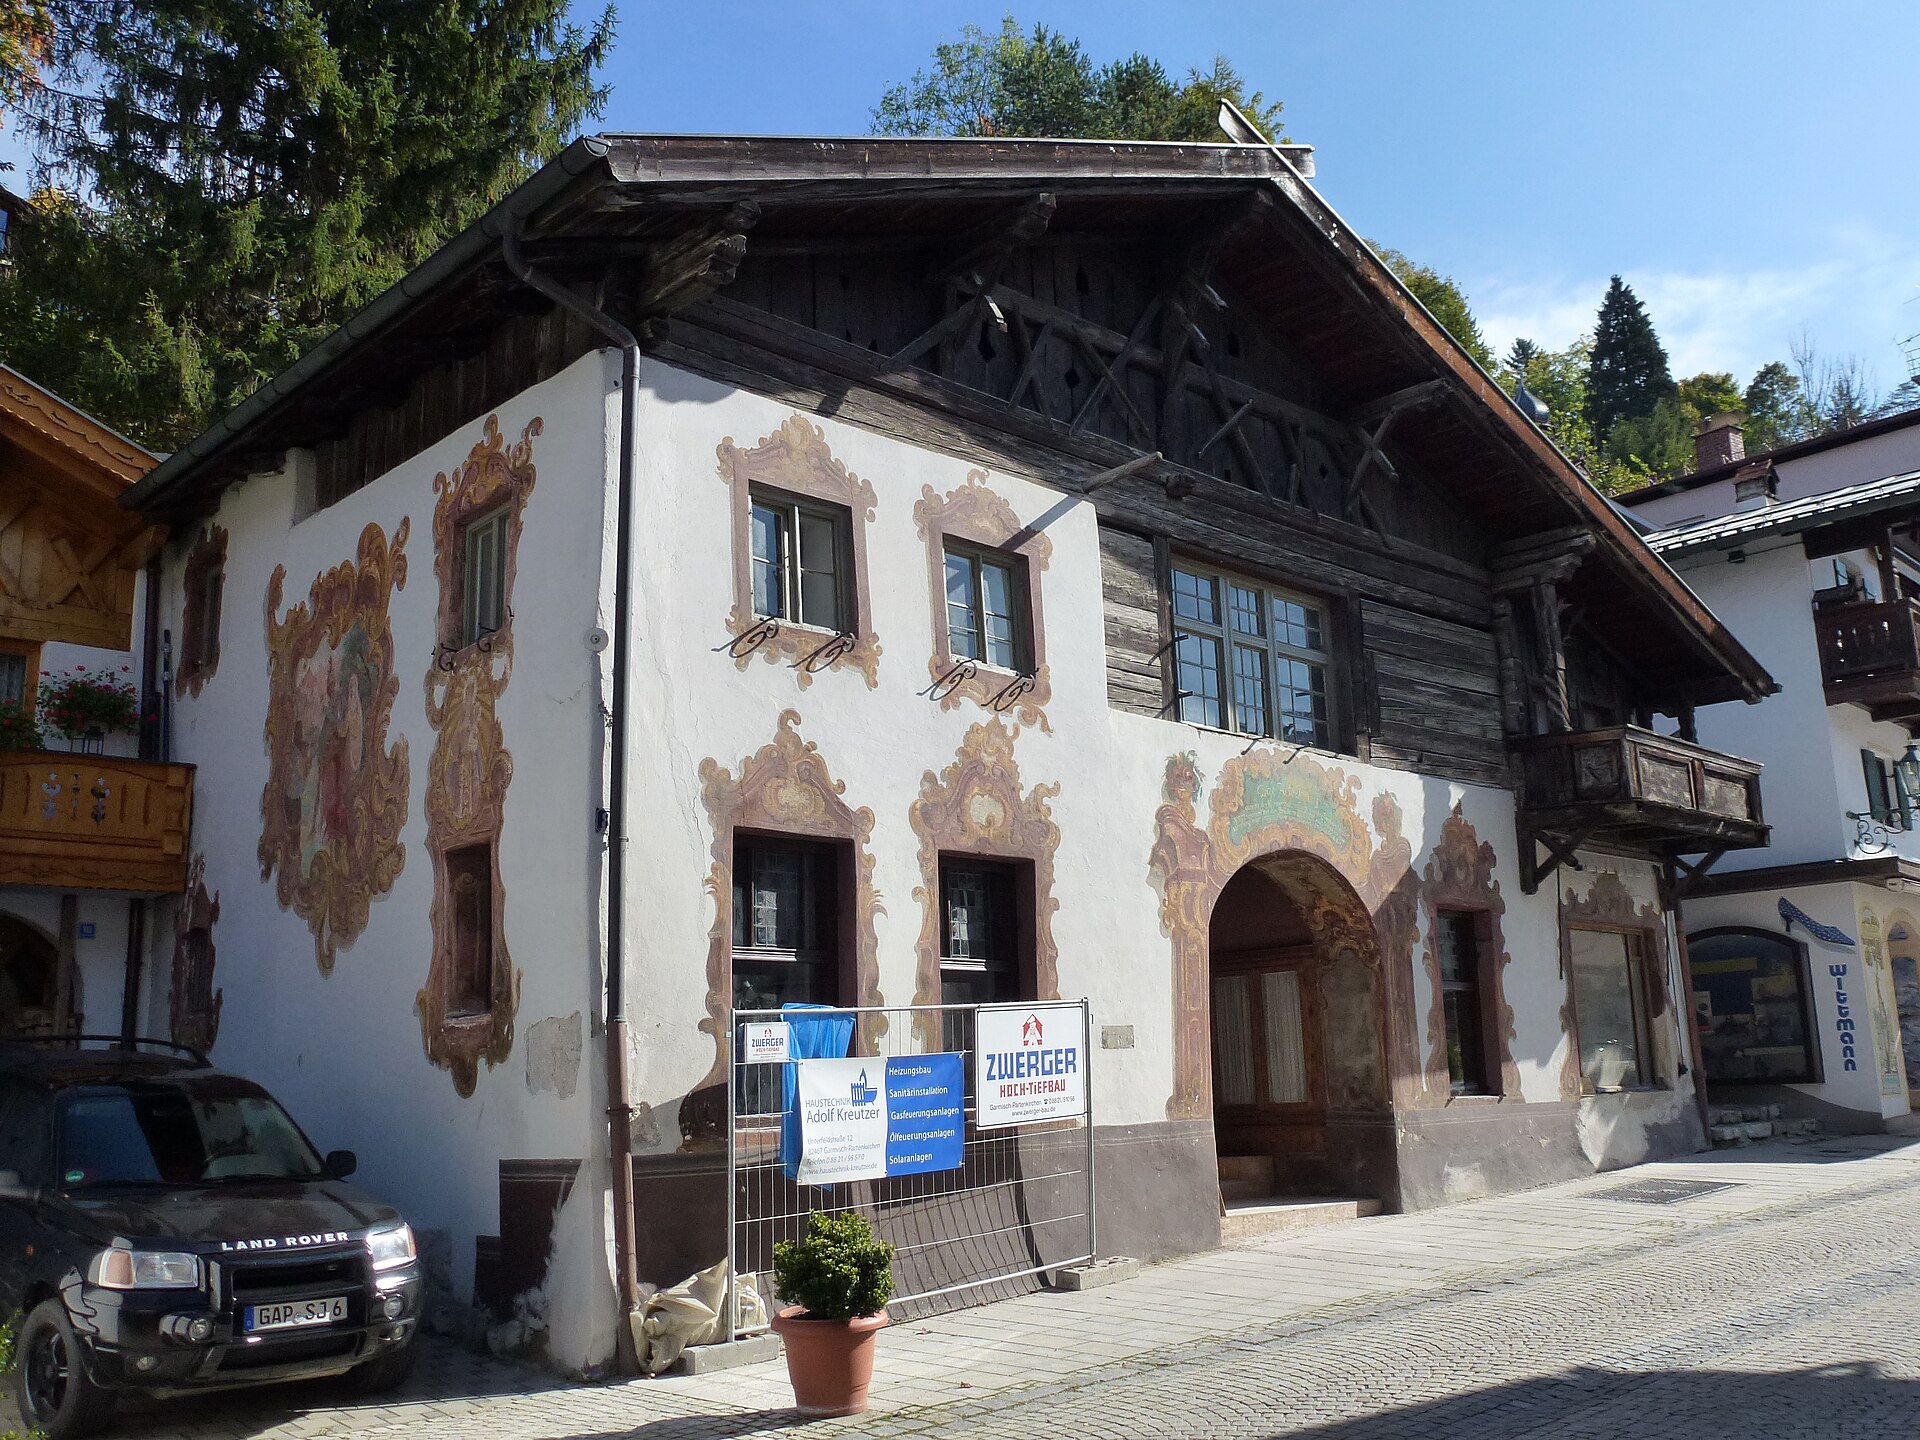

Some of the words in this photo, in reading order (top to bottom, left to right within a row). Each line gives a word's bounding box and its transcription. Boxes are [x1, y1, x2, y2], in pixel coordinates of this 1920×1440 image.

[751, 1037, 784, 1048] ZWERGER
[986, 1047, 1077, 1081] ZWERGER
[888, 1065, 932, 1077] Heizungsbau
[889, 1085, 948, 1098] Sanitärinstallation
[805, 1097, 851, 1108] HAUSTECHNIK
[806, 1107, 834, 1123] Adolf
[837, 1108, 880, 1121] Kreutzer
[890, 1106, 960, 1120] Gasfeuerungsanlagen
[847, 1134, 854, 1143] 12
[889, 1128, 955, 1142] Ölfeuerungsanlagen
[889, 1152, 933, 1165] Solaranlagen
[222, 1238, 277, 1251] LAND
[285, 1231, 349, 1246] ROVER
[260, 1305, 294, 1325] GAP
[305, 1303, 327, 1320] SJ
[332, 1302, 342, 1317] 6
